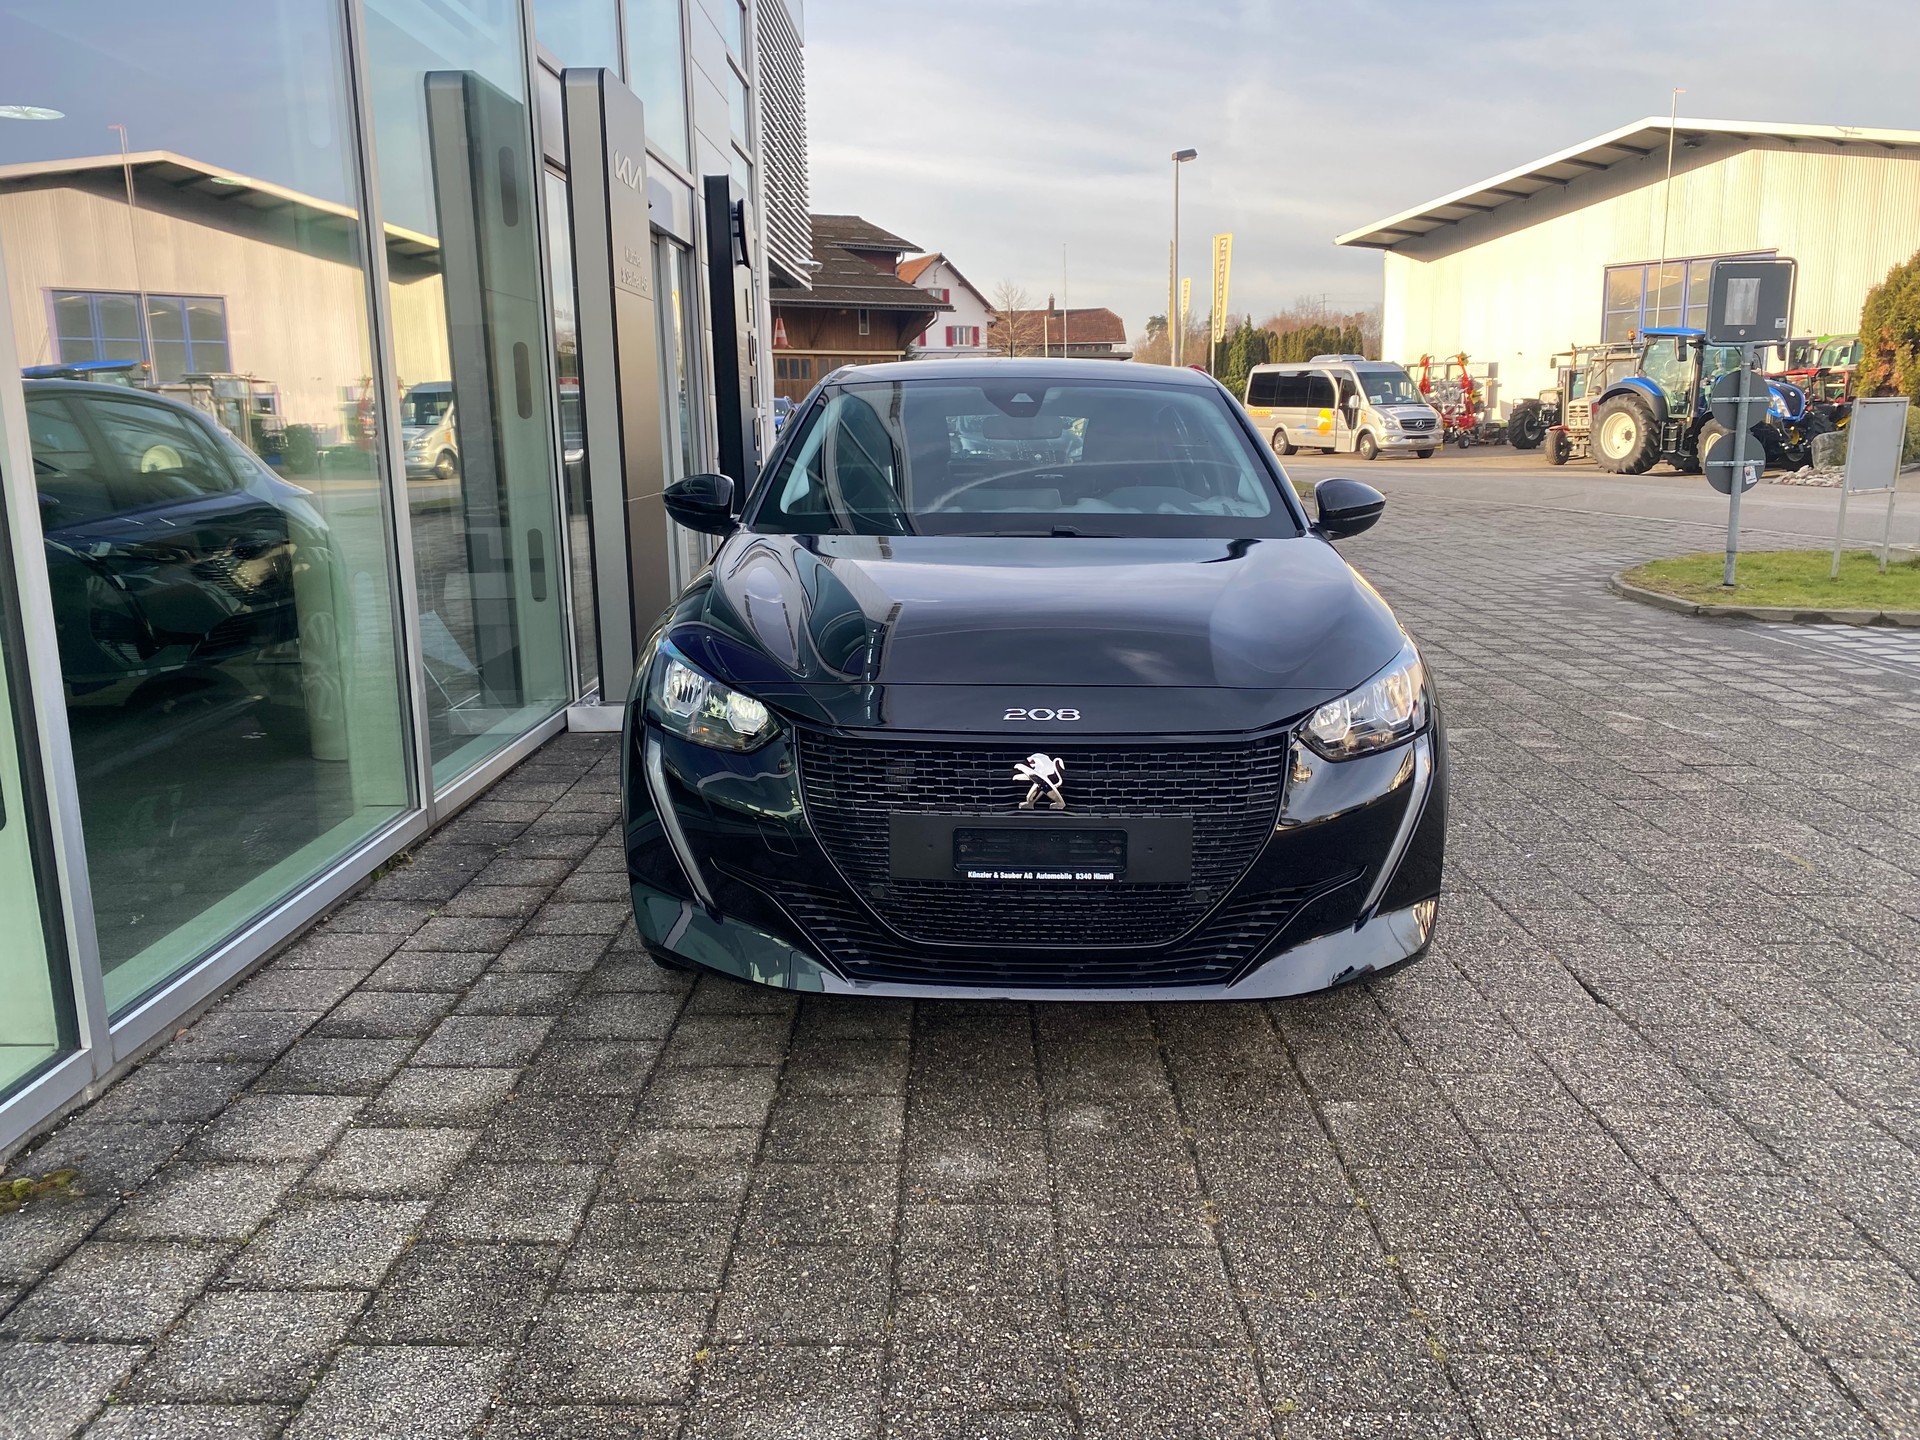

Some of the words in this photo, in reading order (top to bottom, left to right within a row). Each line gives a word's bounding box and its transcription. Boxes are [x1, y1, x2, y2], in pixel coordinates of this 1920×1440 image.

[1003, 708, 1081, 720] 208
[967, 871, 992, 879] Künzler
[1023, 872, 1033, 880] AG
[1036, 872, 1072, 880] Automobile
